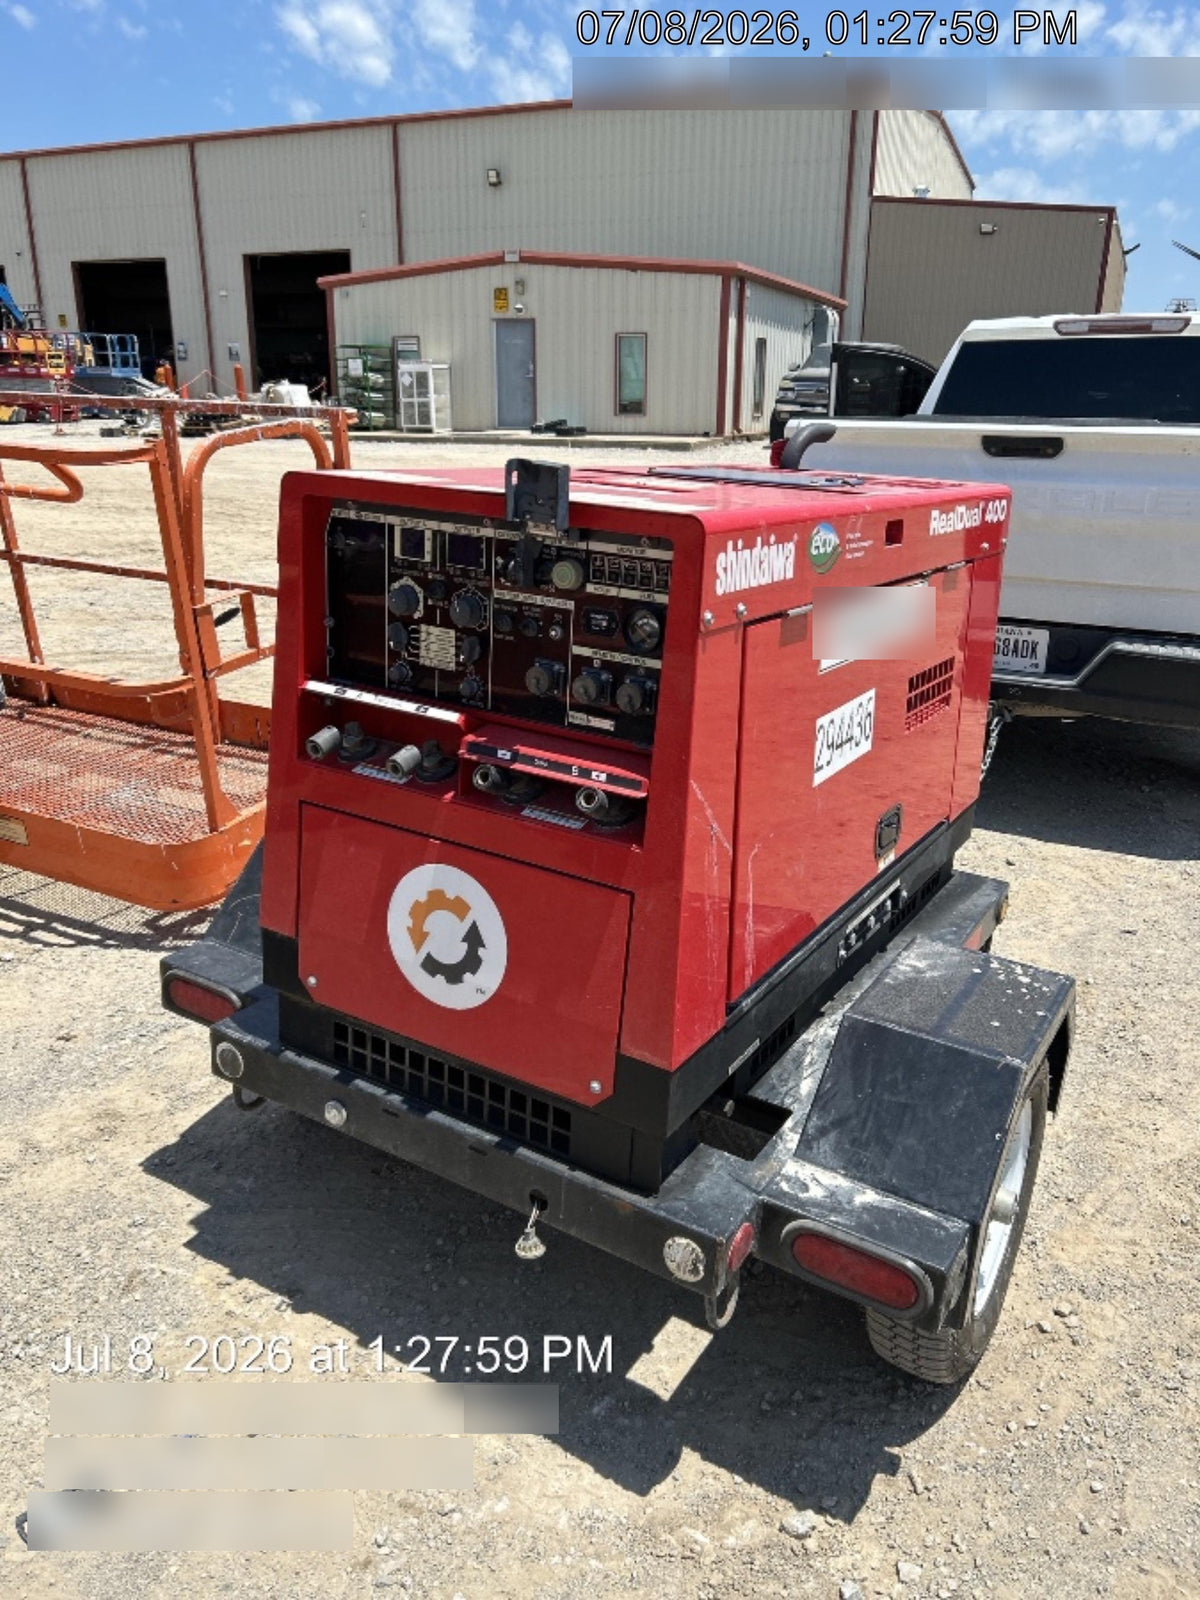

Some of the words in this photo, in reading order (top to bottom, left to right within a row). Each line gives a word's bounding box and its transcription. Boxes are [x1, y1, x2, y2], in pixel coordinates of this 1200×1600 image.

[929, 502, 983, 537] RealDual
[985, 499, 1008, 524] 400
[715, 533, 796, 597] shindaiwa
[810, 532, 835, 556] eco
[814, 696, 873, 774] 294436
